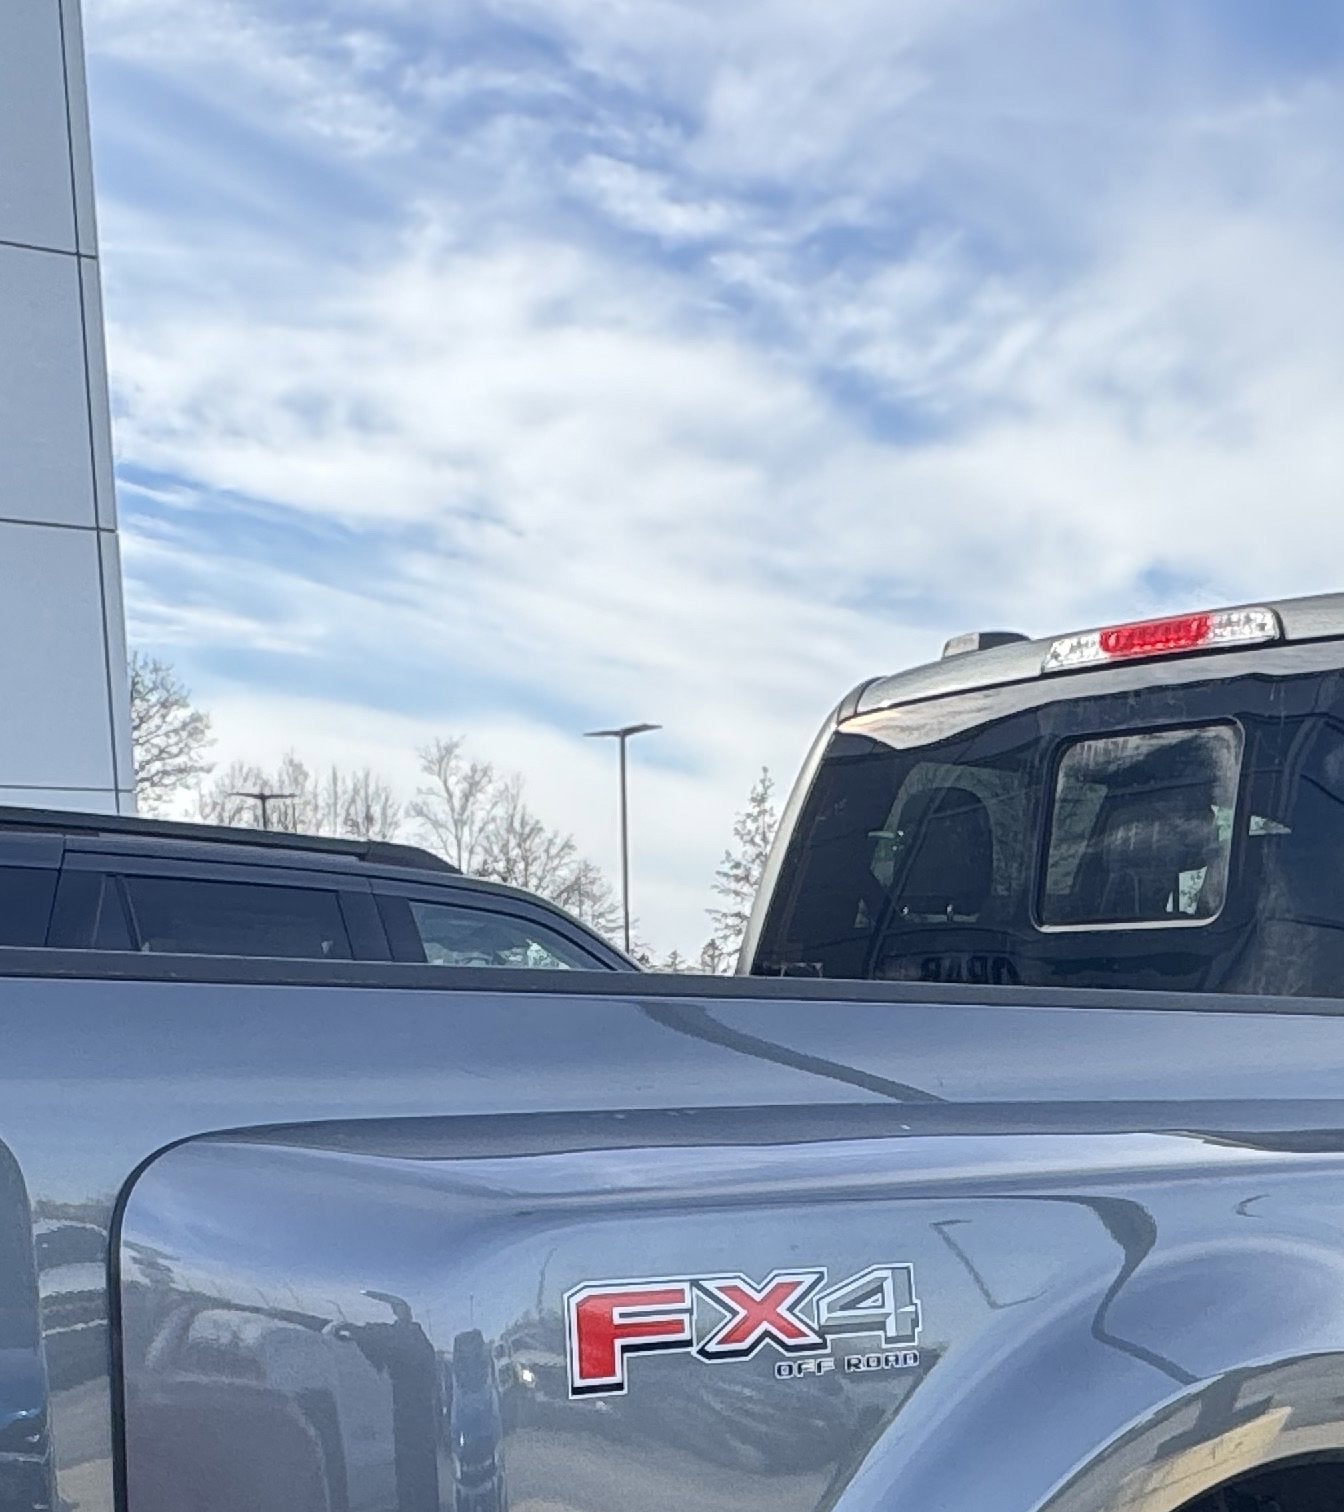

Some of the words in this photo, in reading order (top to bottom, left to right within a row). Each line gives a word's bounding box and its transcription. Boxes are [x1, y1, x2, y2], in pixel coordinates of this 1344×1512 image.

[564, 1263, 922, 1399] FX4
[775, 1359, 835, 1379] OFF
[845, 1351, 920, 1373] ROAD
